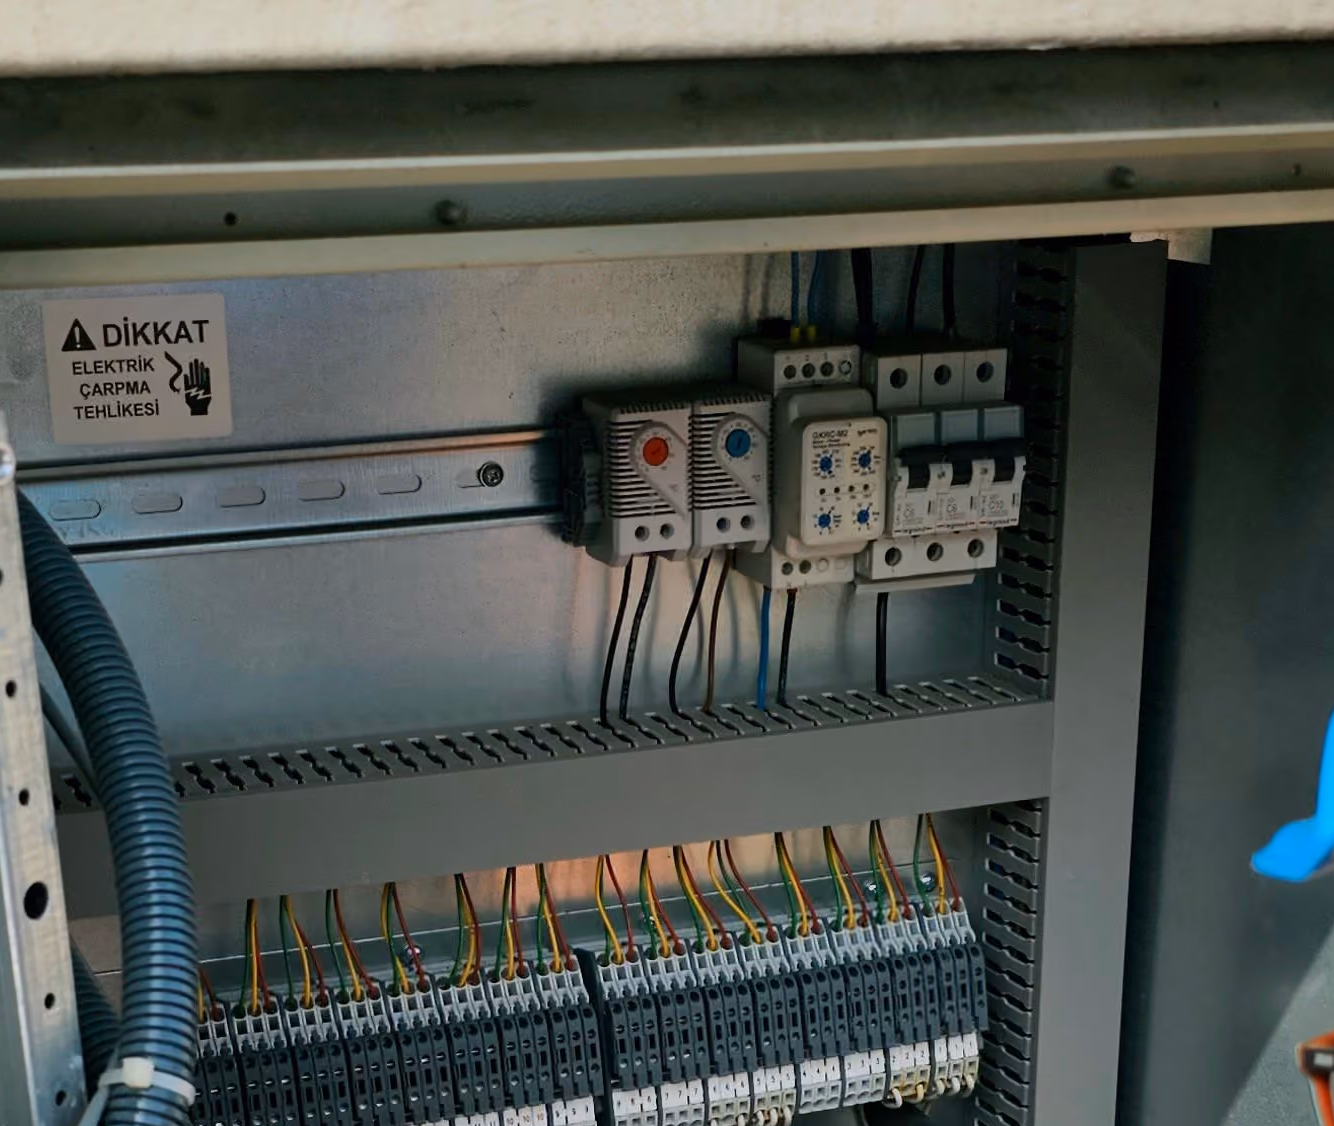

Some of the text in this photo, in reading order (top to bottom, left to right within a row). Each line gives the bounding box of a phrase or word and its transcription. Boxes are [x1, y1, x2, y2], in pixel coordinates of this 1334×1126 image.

[102, 316, 210, 347] DİKKAT
[72, 355, 155, 375] ELEKTRİK
[79, 380, 151, 400] ÇARPMA
[73, 398, 160, 420] TEHLİKESİ
